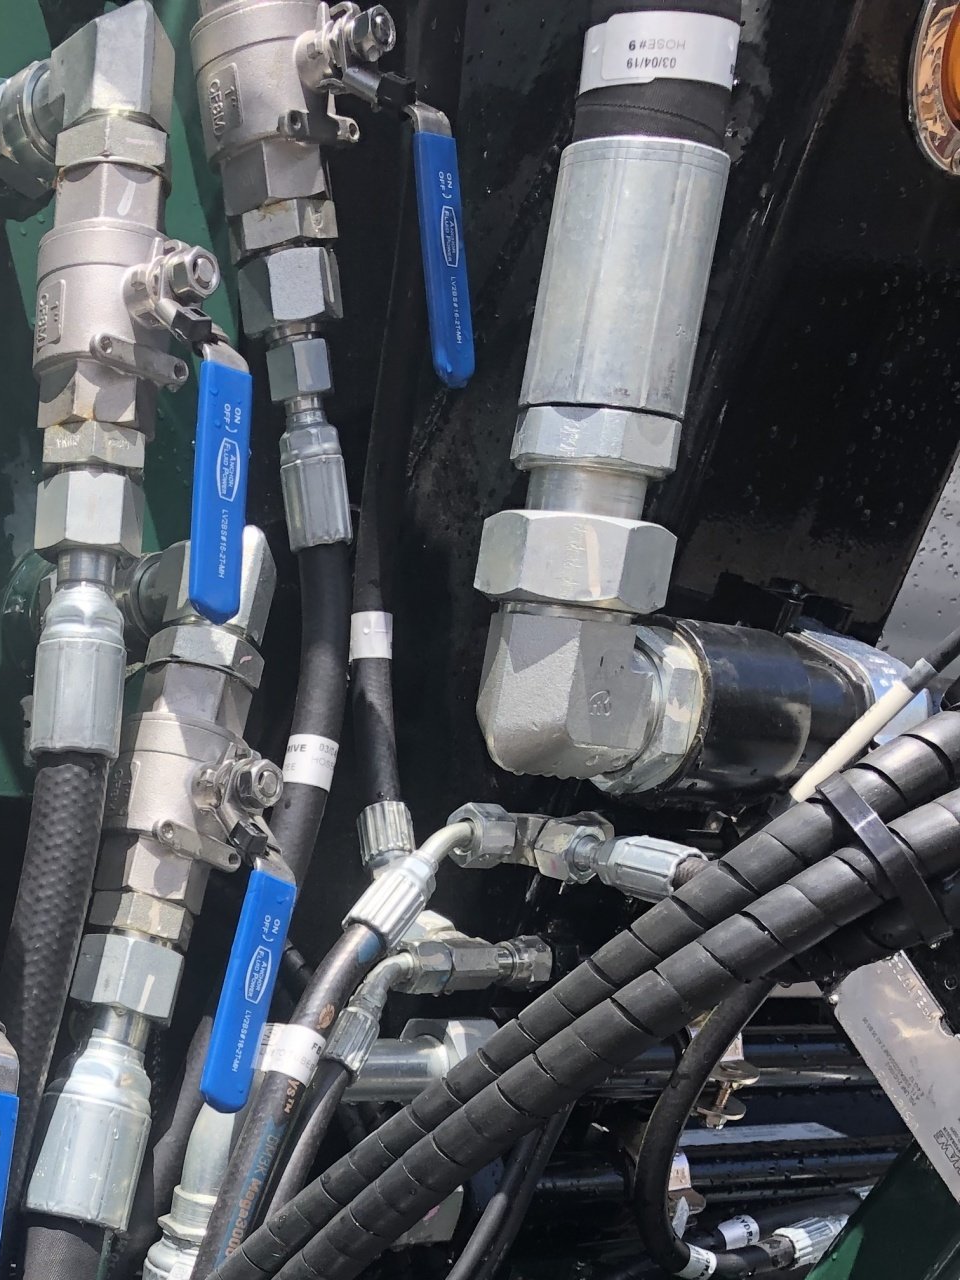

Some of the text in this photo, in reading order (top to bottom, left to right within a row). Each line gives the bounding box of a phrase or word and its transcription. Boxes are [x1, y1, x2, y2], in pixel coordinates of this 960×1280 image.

[627, 39, 685, 50] HOSE# 9
[626, 57, 675, 68] 03/04/19
[446, 172, 452, 188] ON
[223, 403, 231, 424] OFF
[233, 407, 241, 423] ON
[261, 914, 271, 933] OFF
[271, 918, 280, 933] ON
